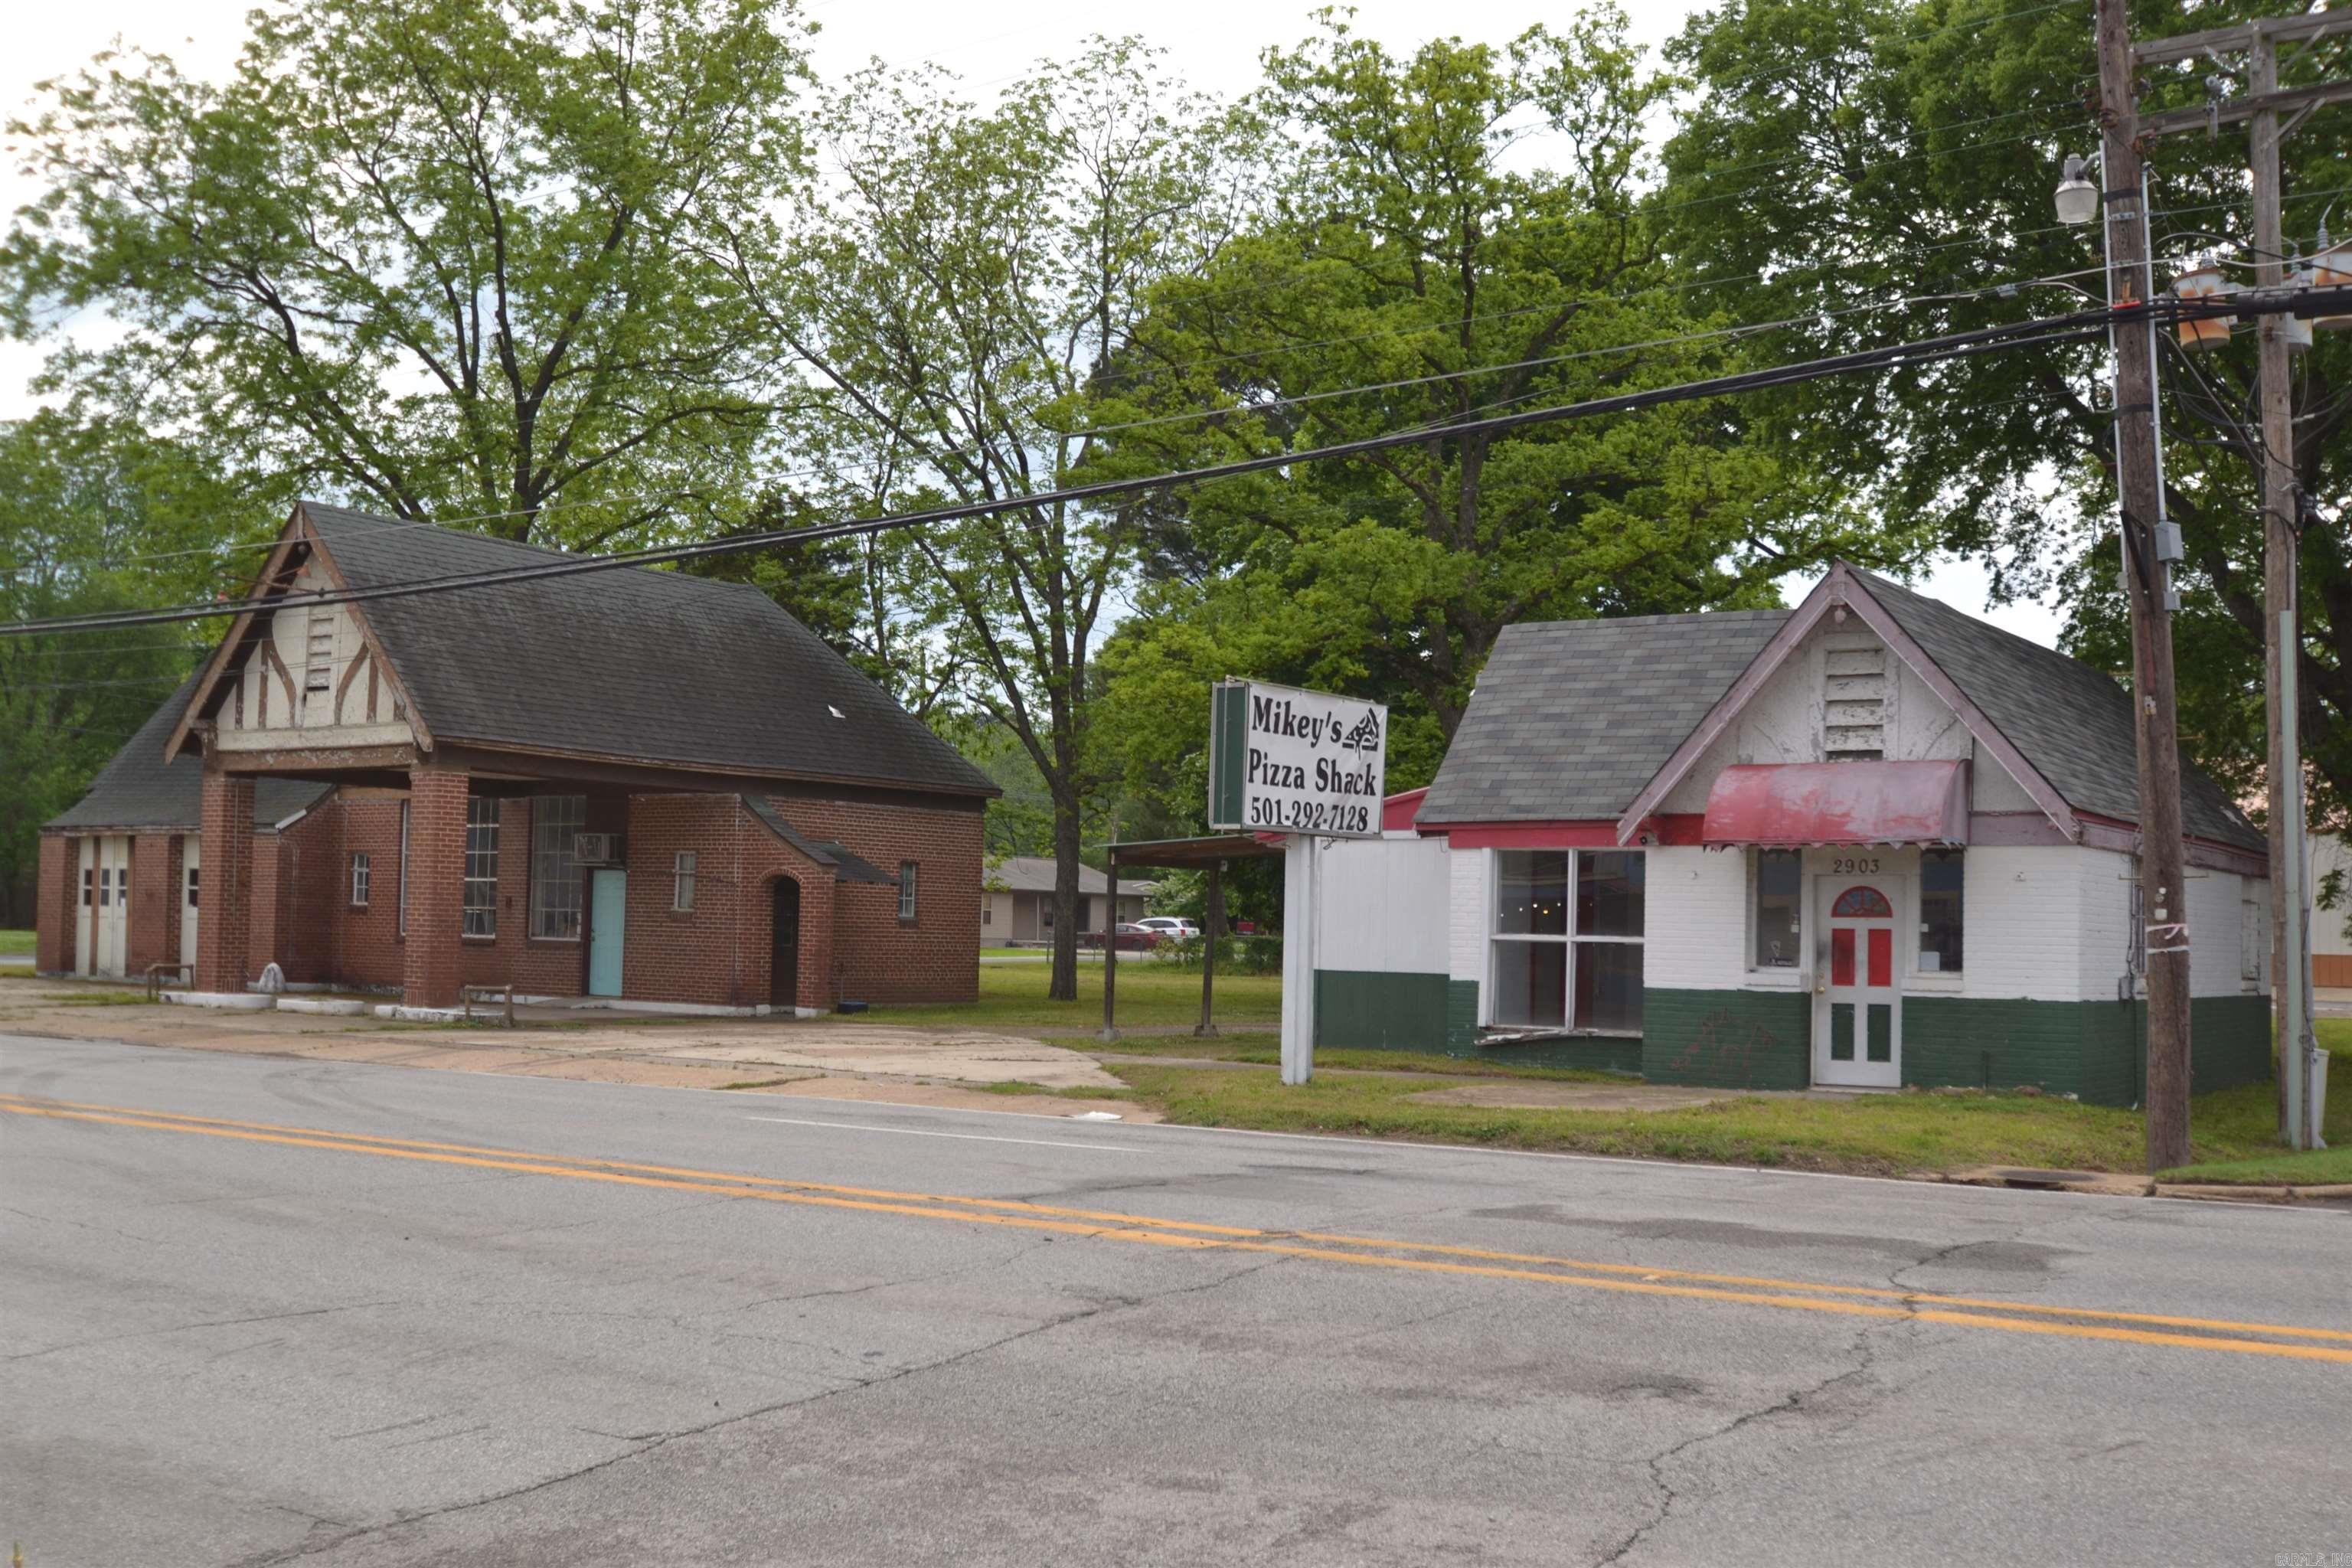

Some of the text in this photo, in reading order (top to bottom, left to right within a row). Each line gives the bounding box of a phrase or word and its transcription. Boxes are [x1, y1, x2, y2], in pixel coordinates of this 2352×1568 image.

[1252, 695, 1342, 748] Mikey's
[1248, 747, 1377, 796] Pizza Shack
[1250, 796, 1368, 832] 501-292-7128
[1833, 858, 1880, 874] 2903
